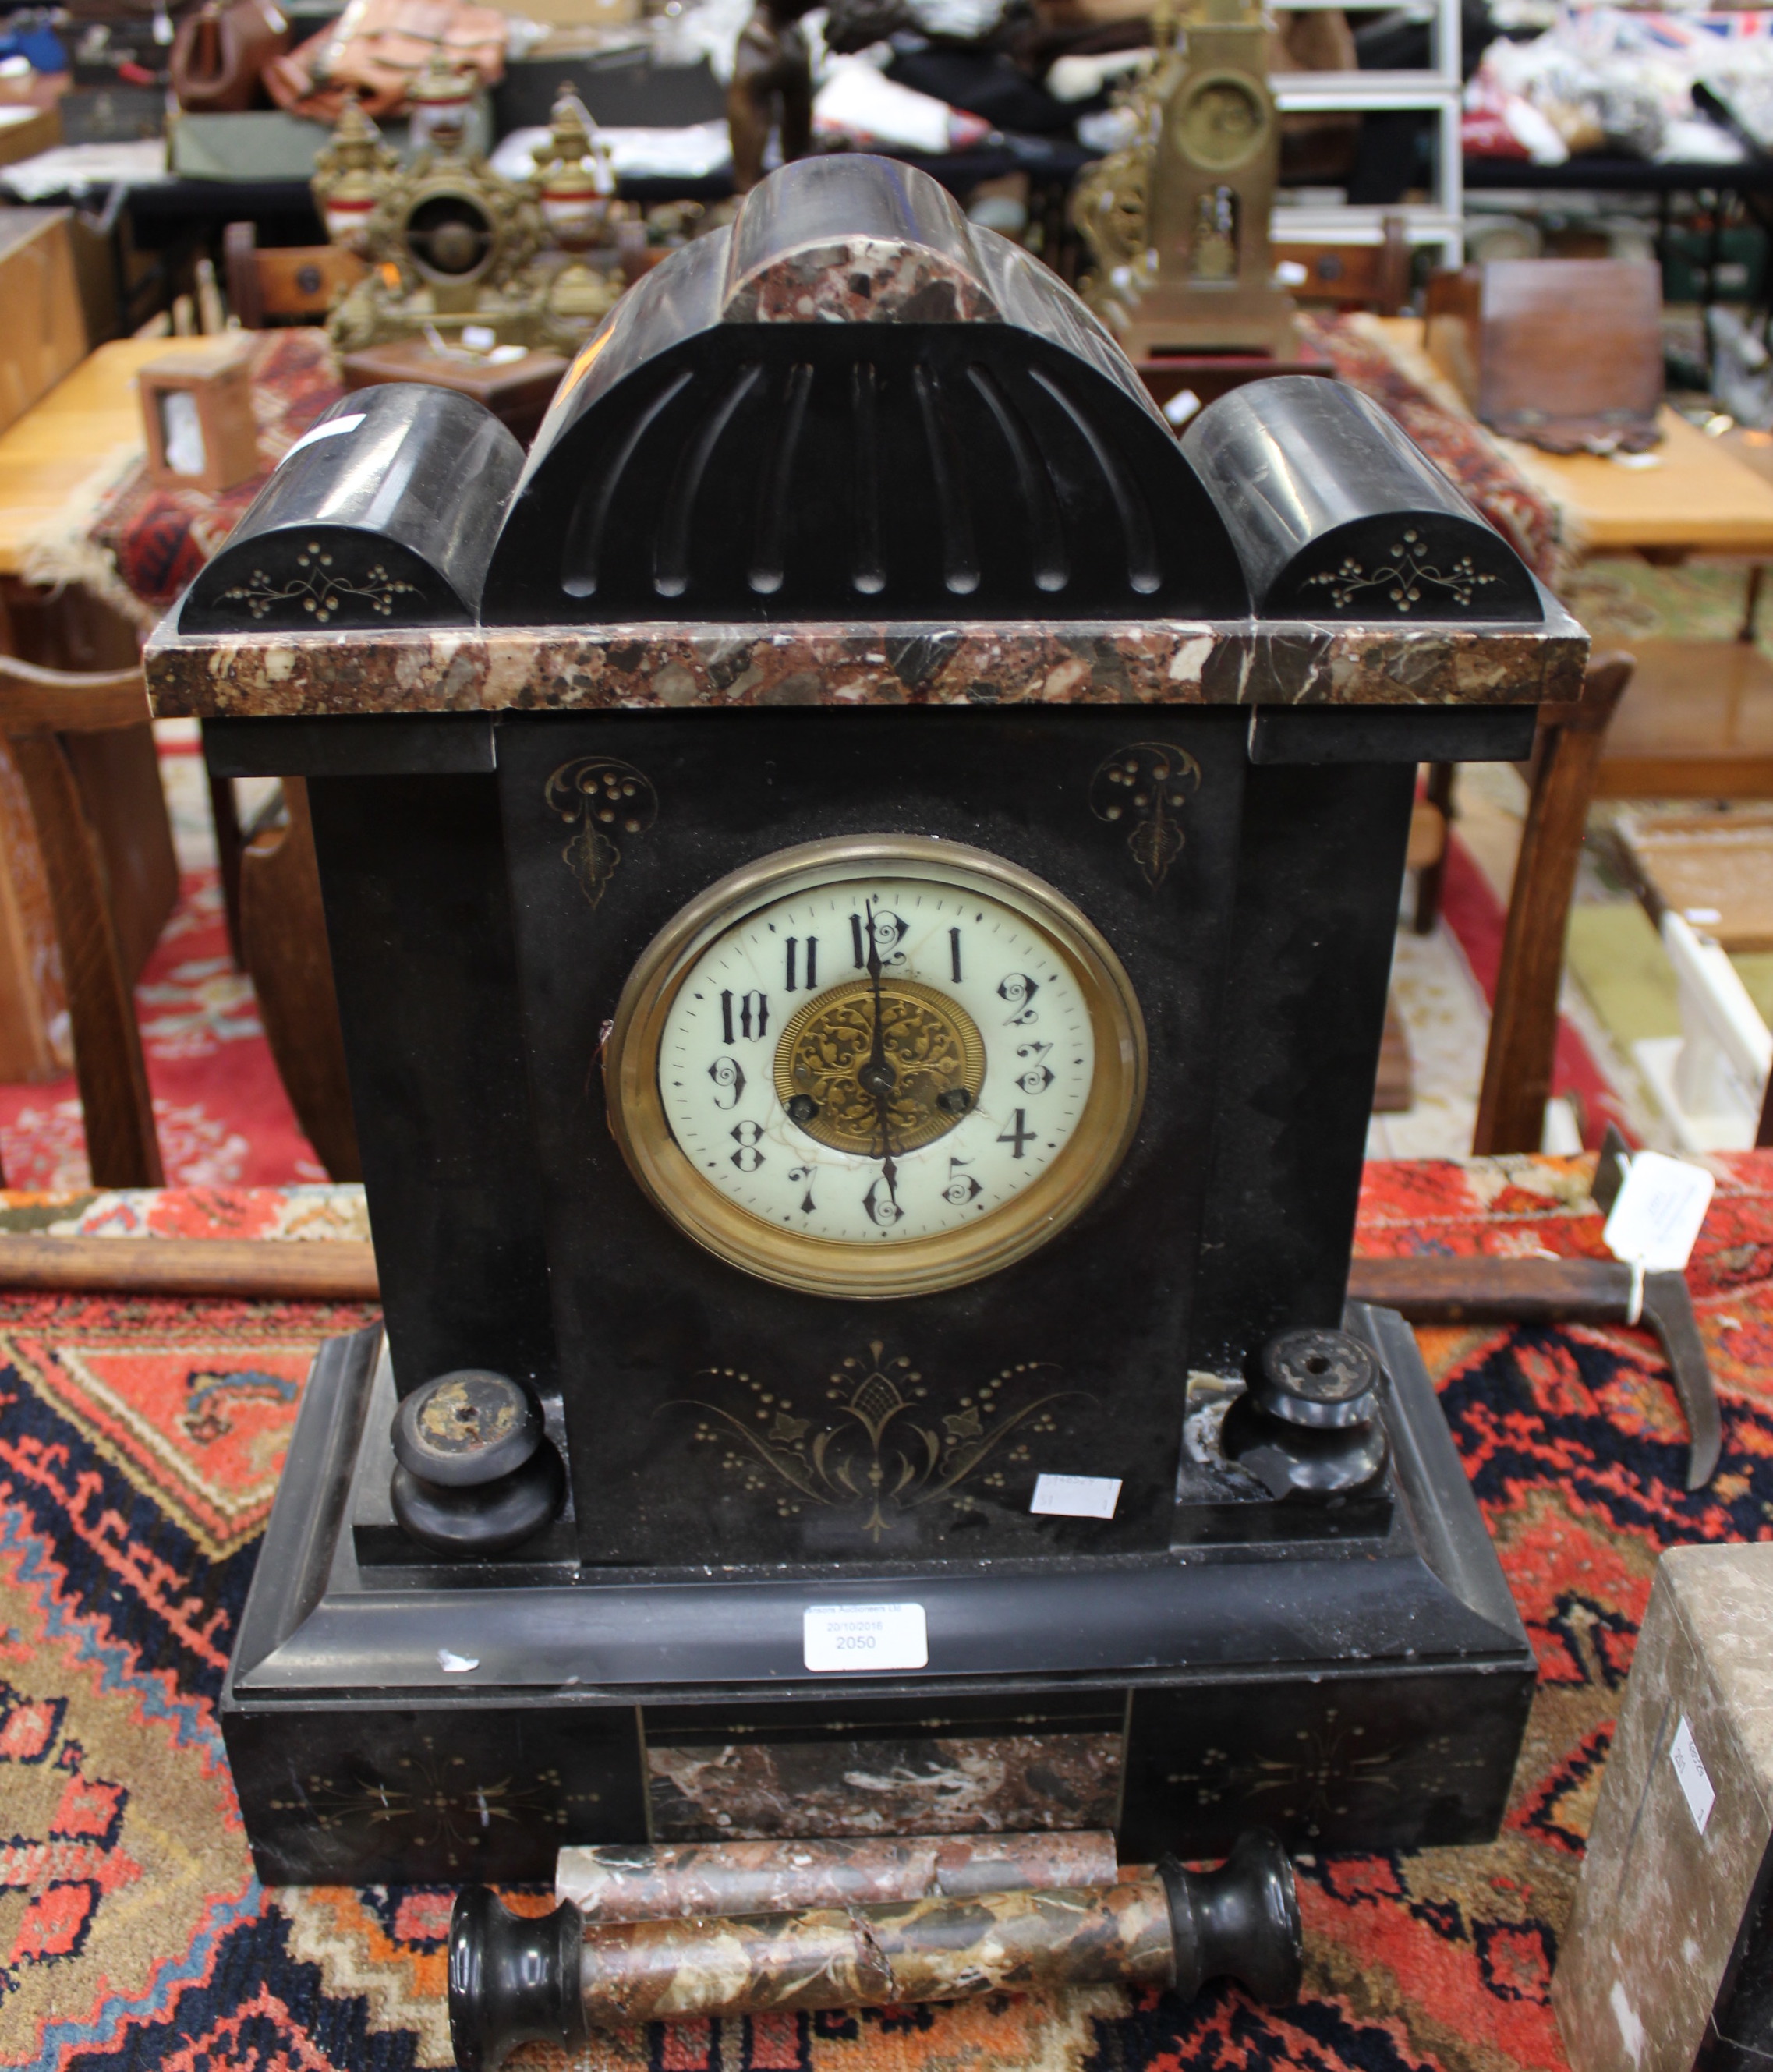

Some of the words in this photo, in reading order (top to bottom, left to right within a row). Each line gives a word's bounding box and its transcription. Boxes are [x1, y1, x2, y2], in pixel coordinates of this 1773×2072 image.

[784, 935, 818, 992] 11
[849, 910, 911, 969] 12
[948, 927, 963, 984] 1
[720, 989, 768, 1044] 10
[996, 973, 1039, 1027] 2
[707, 1056, 747, 1110] 9
[1015, 1042, 1054, 1094] 3
[730, 1119, 766, 1172] 8
[996, 1108, 1039, 1158] 4
[787, 1165, 816, 1214] 7
[862, 1177, 904, 1226] 6
[942, 1156, 982, 1204] 5
[836, 1635, 876, 1650] 2050
